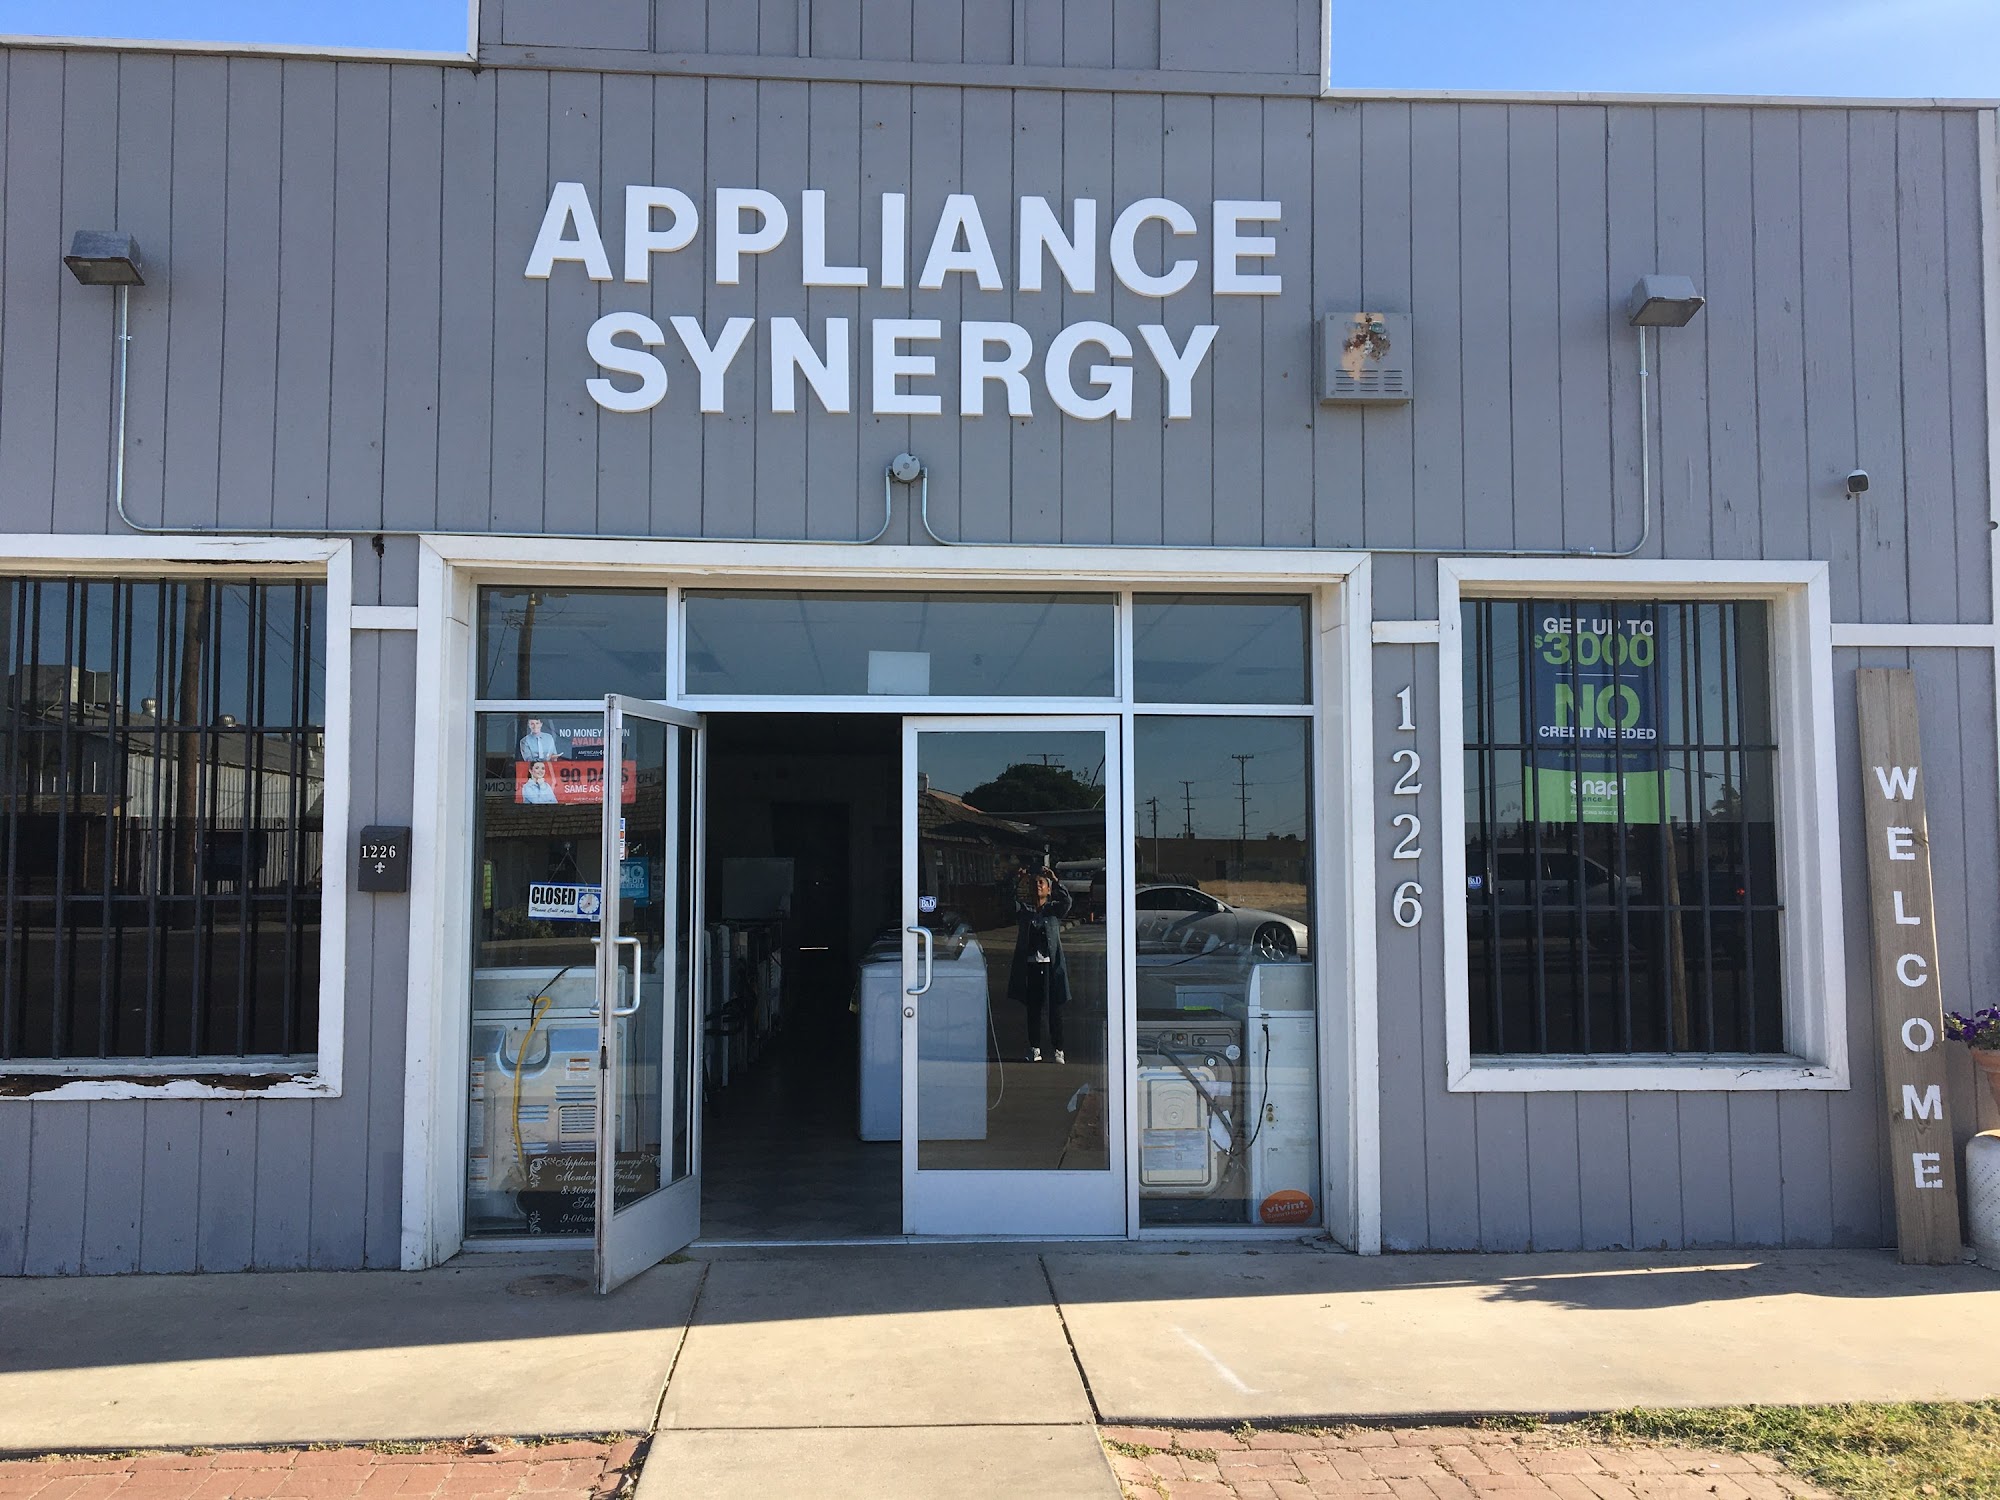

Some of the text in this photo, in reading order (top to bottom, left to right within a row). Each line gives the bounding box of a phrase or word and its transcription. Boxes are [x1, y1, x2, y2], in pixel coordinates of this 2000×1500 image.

[523, 181, 1283, 298] APPLIANCE
[585, 311, 1220, 420] SYNERGY
[1542, 617, 1586, 634] GET
[1626, 619, 1654, 637] TO
[1555, 683, 1641, 729] NO
[559, 729, 603, 738] NO MONEY
[560, 768, 581, 783] 90
[564, 785, 588, 793] SAME
[589, 785, 600, 793] AS
[1570, 778, 1627, 800] snap!
[1392, 685, 1423, 928] 1226
[362, 845, 396, 858] 1226
[532, 886, 576, 905] CLOSED
[921, 899, 935, 908] B&D
[1873, 766, 1944, 1189] WELCOME
[556, 1156, 596, 1170] Applianc
[556, 1168, 642, 1184] Monday Friday
[1265, 1200, 1308, 1213] vivint.
